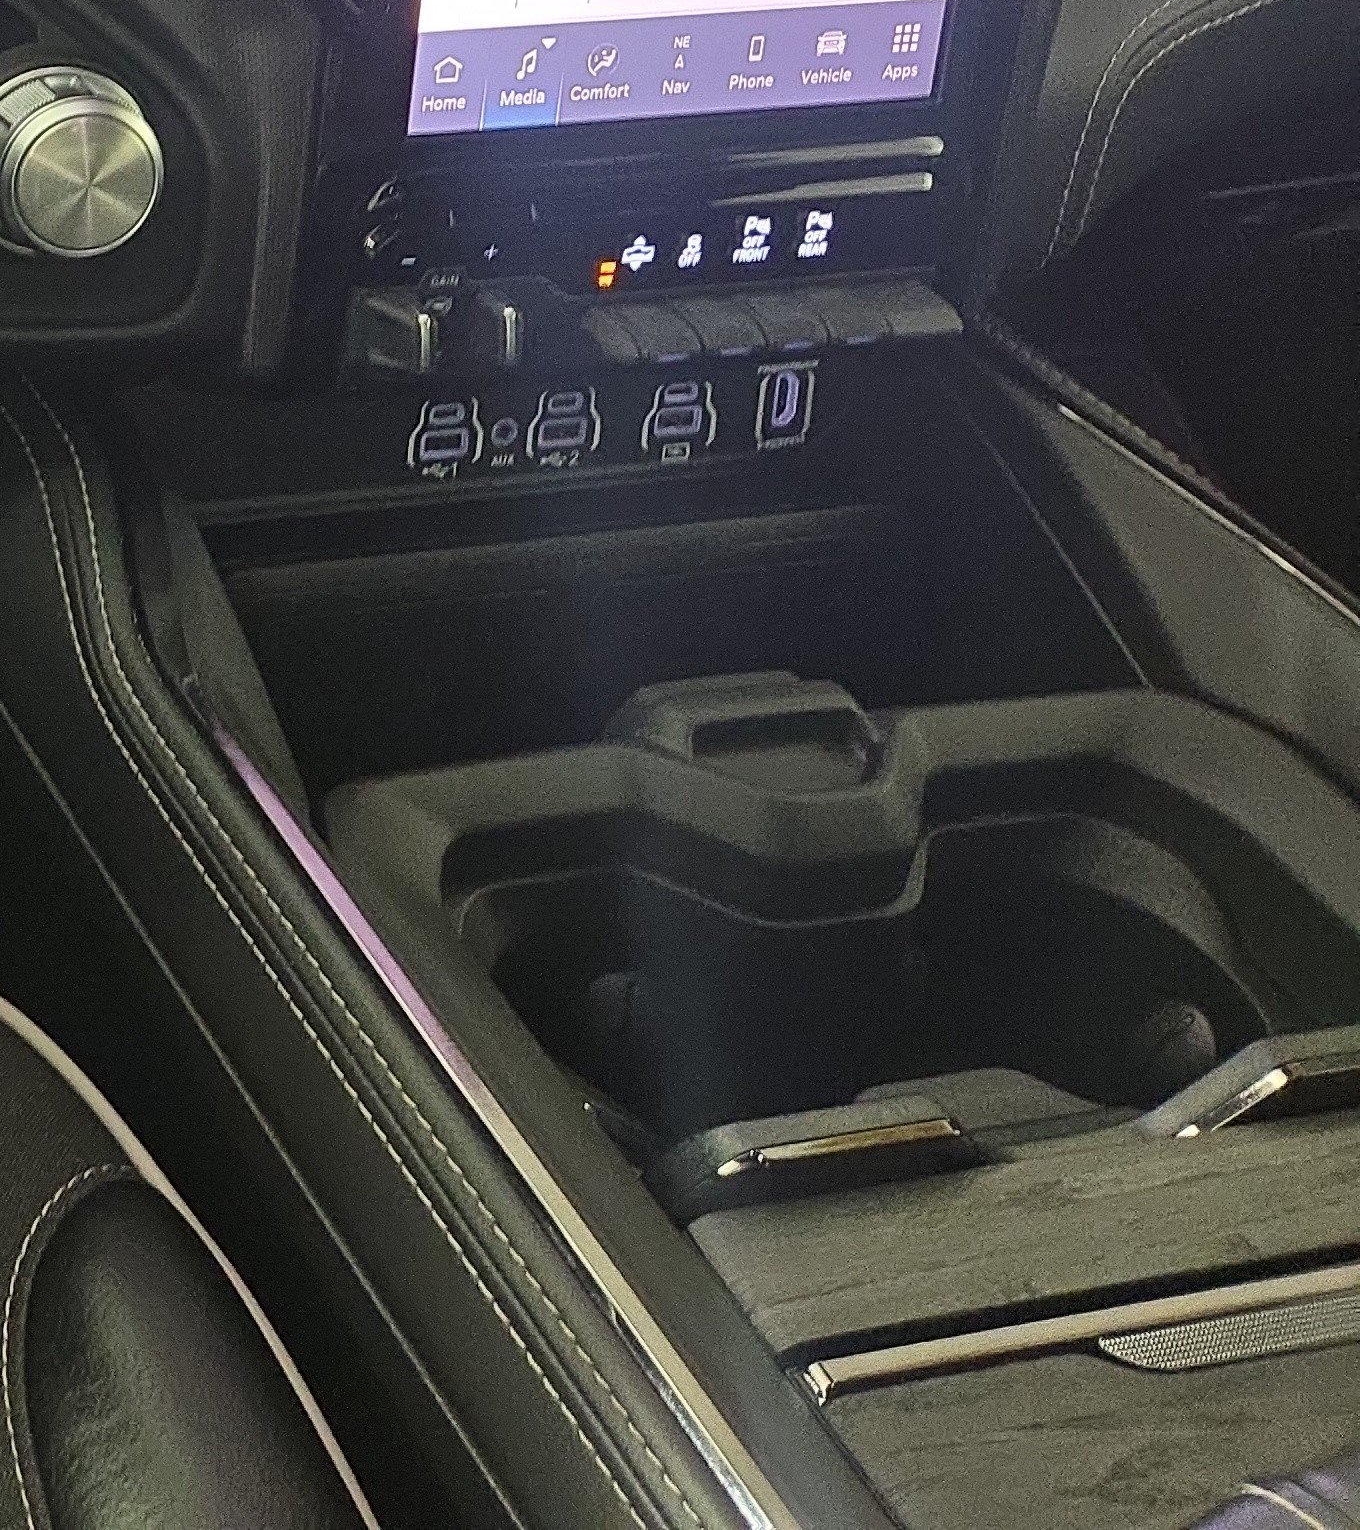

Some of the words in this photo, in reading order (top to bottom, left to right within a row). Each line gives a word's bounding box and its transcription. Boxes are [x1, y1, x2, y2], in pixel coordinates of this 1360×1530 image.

[673, 35, 691, 49] NE
[801, 67, 852, 86] Vehicle
[882, 63, 918, 82] Apps
[662, 79, 690, 95] Nav
[729, 74, 774, 91] Phone
[500, 89, 545, 107] Media
[570, 83, 630, 102] Comfort
[422, 96, 467, 113] Home
[743, 235, 766, 249] OFF
[804, 230, 827, 243] OFF
[732, 246, 771, 263] FRONT
[798, 241, 829, 258] REAR
[678, 252, 701, 268] OFF
